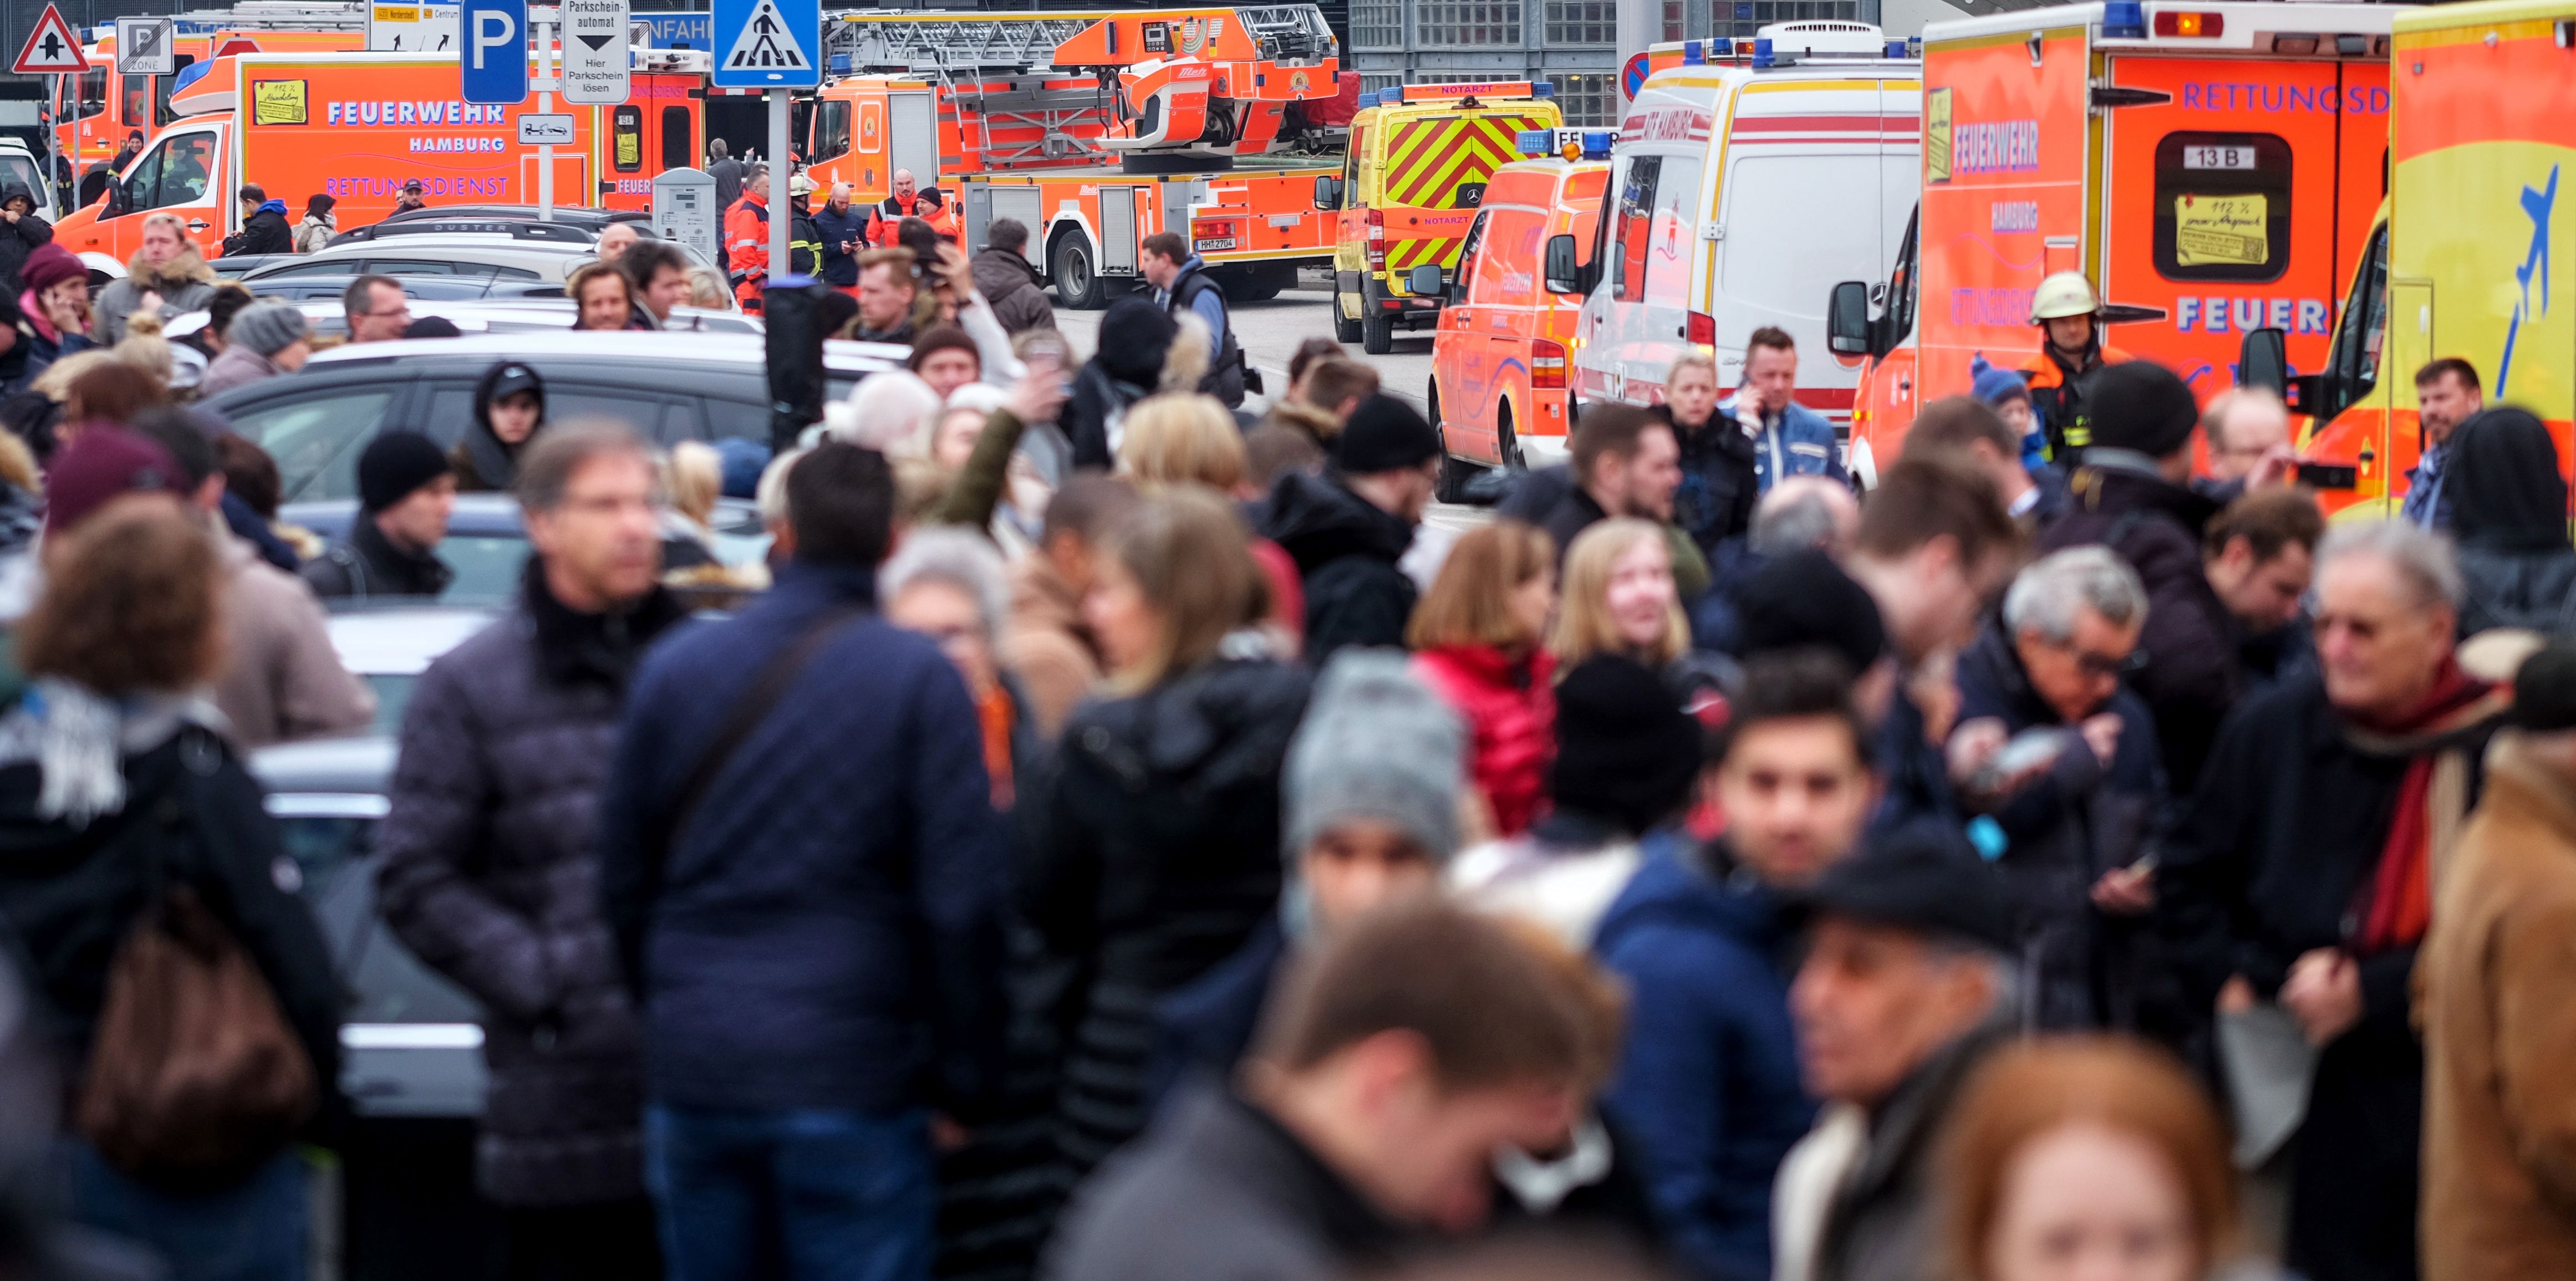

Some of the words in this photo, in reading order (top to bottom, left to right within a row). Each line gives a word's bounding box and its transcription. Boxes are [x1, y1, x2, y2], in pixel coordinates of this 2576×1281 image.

[569, 1, 624, 13] Parkschein-
[390, 10, 414, 19] Norderstedt
[435, 10, 459, 18] Centrum
[578, 17, 614, 27] automat
[651, 20, 712, 39] NFAH
[474, 10, 515, 69] P
[131, 61, 159, 70] ZONE
[586, 59, 605, 68] Hier
[569, 71, 623, 80] Parkschein
[1178, 67, 1207, 78] Metz
[583, 84, 609, 92] lösen
[631, 85, 684, 98] TUNGSDIENST
[1442, 85, 1493, 94] NOTARZT
[2183, 83, 2390, 114] RETTUNGSD
[328, 101, 505, 125] FEUERWEHR
[410, 137, 505, 152] HAMBURG
[1954, 120, 2039, 173] FEUERWEHR
[2197, 149, 2218, 166] 13
[2224, 150, 2239, 166] B
[327, 177, 508, 196] RETTUNSDIENST
[618, 178, 653, 195] FEUER
[2211, 202, 2233, 214] 112
[1992, 201, 2037, 233] HAMBURG
[1202, 241, 1211, 249] HH
[1215, 239, 1232, 248] 2704
[1951, 288, 2037, 326] RETTUNGSDIENS
[2177, 297, 2348, 335] FEUER
